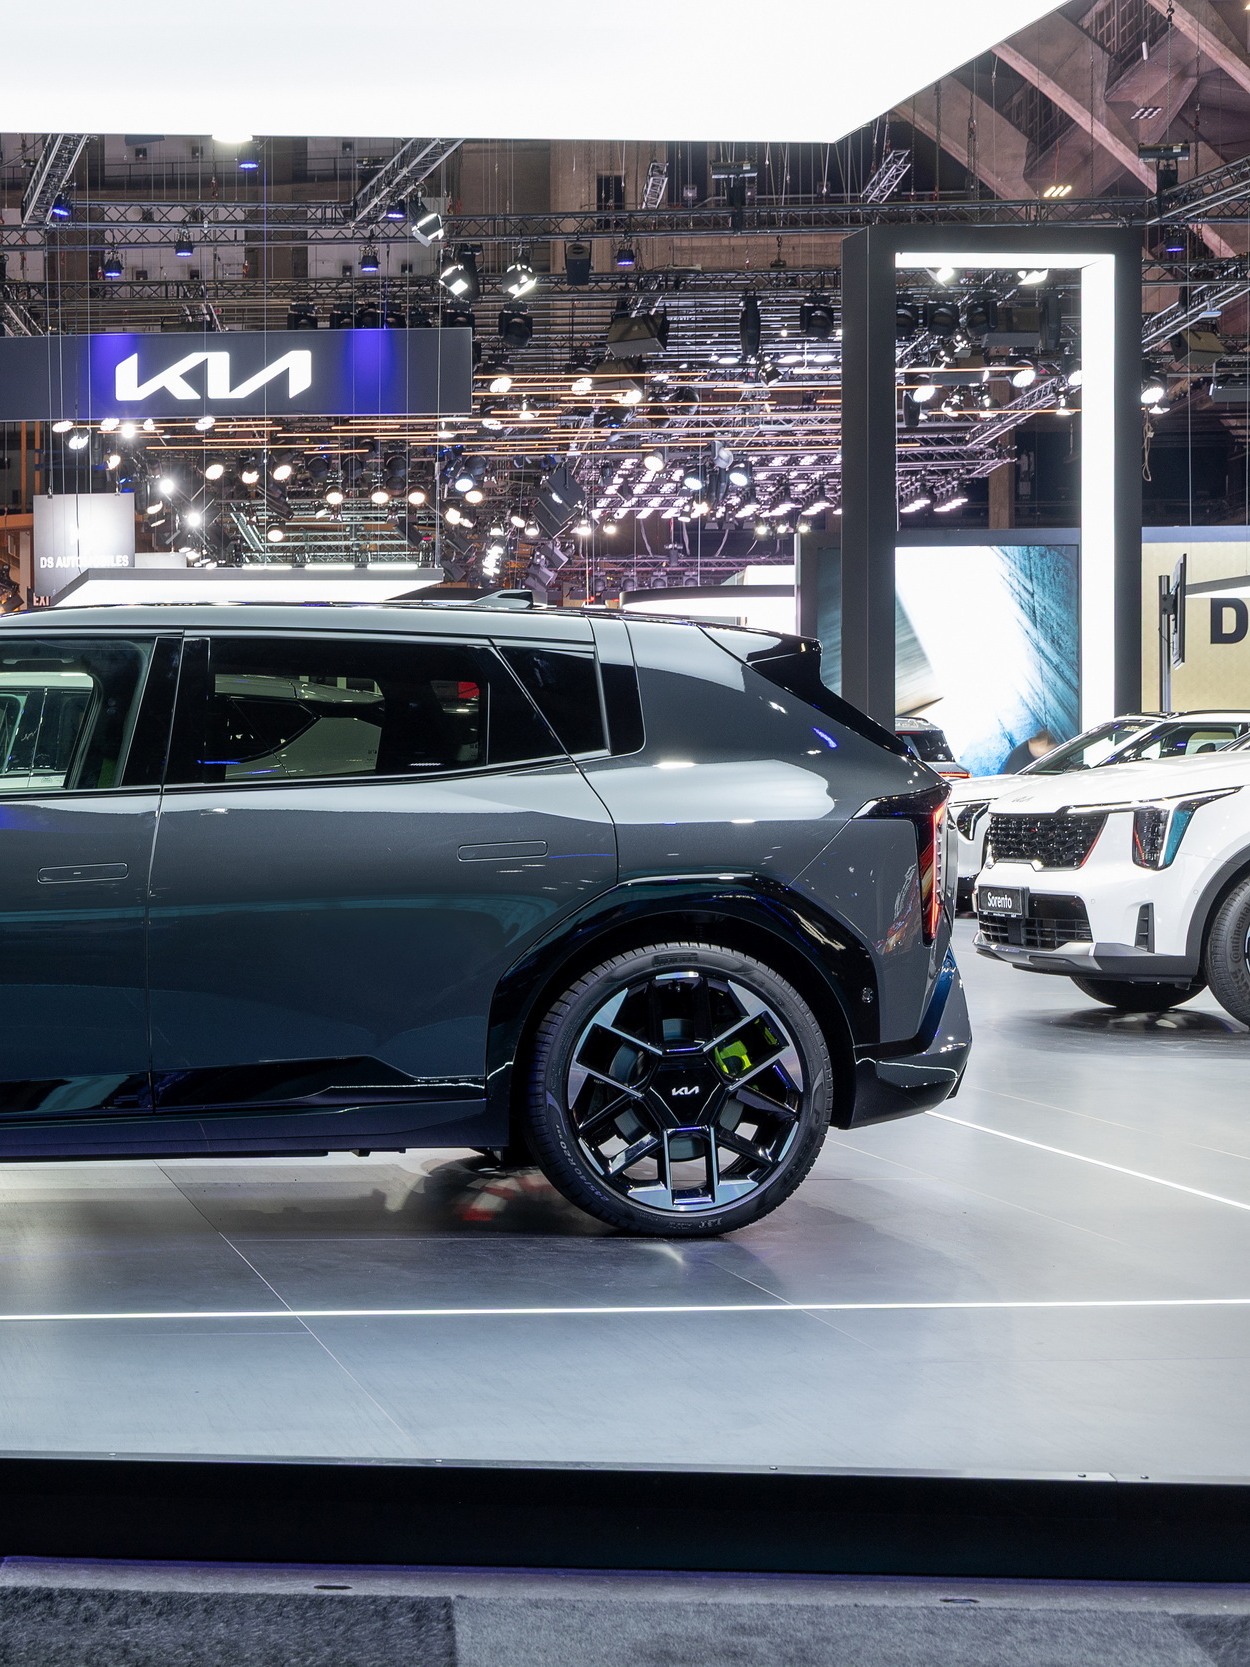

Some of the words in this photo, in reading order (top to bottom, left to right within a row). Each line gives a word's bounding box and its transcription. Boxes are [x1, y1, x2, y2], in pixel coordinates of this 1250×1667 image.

[115, 350, 312, 401] KIA
[40, 556, 54, 568] DS
[56, 555, 129, 568] AUTOLES
[1210, 598, 1249, 644] D
[987, 892, 1013, 909] Sorento
[671, 1086, 700, 1096] KIA
[556, 1140, 576, 1168] R20
